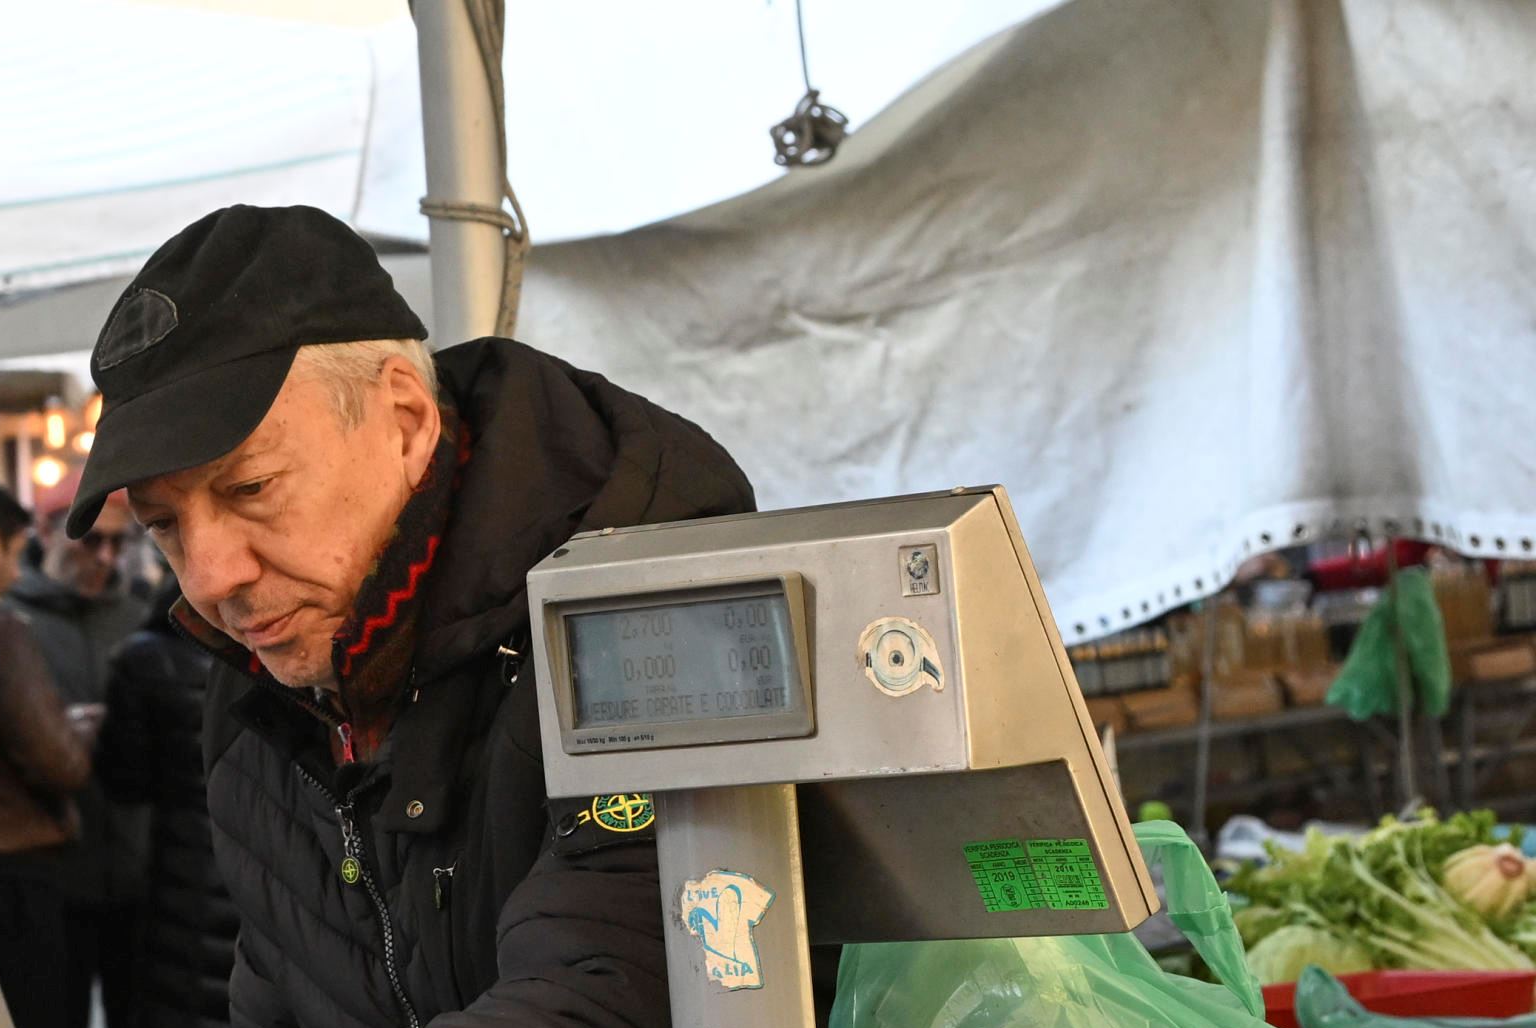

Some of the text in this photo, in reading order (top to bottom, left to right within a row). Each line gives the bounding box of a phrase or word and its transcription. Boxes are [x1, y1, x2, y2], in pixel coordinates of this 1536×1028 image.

[723, 602, 769, 631] 0,00
[623, 654, 677, 682] 0,000
[727, 645, 772, 673] 0,00
[992, 870, 1016, 883] 2019
